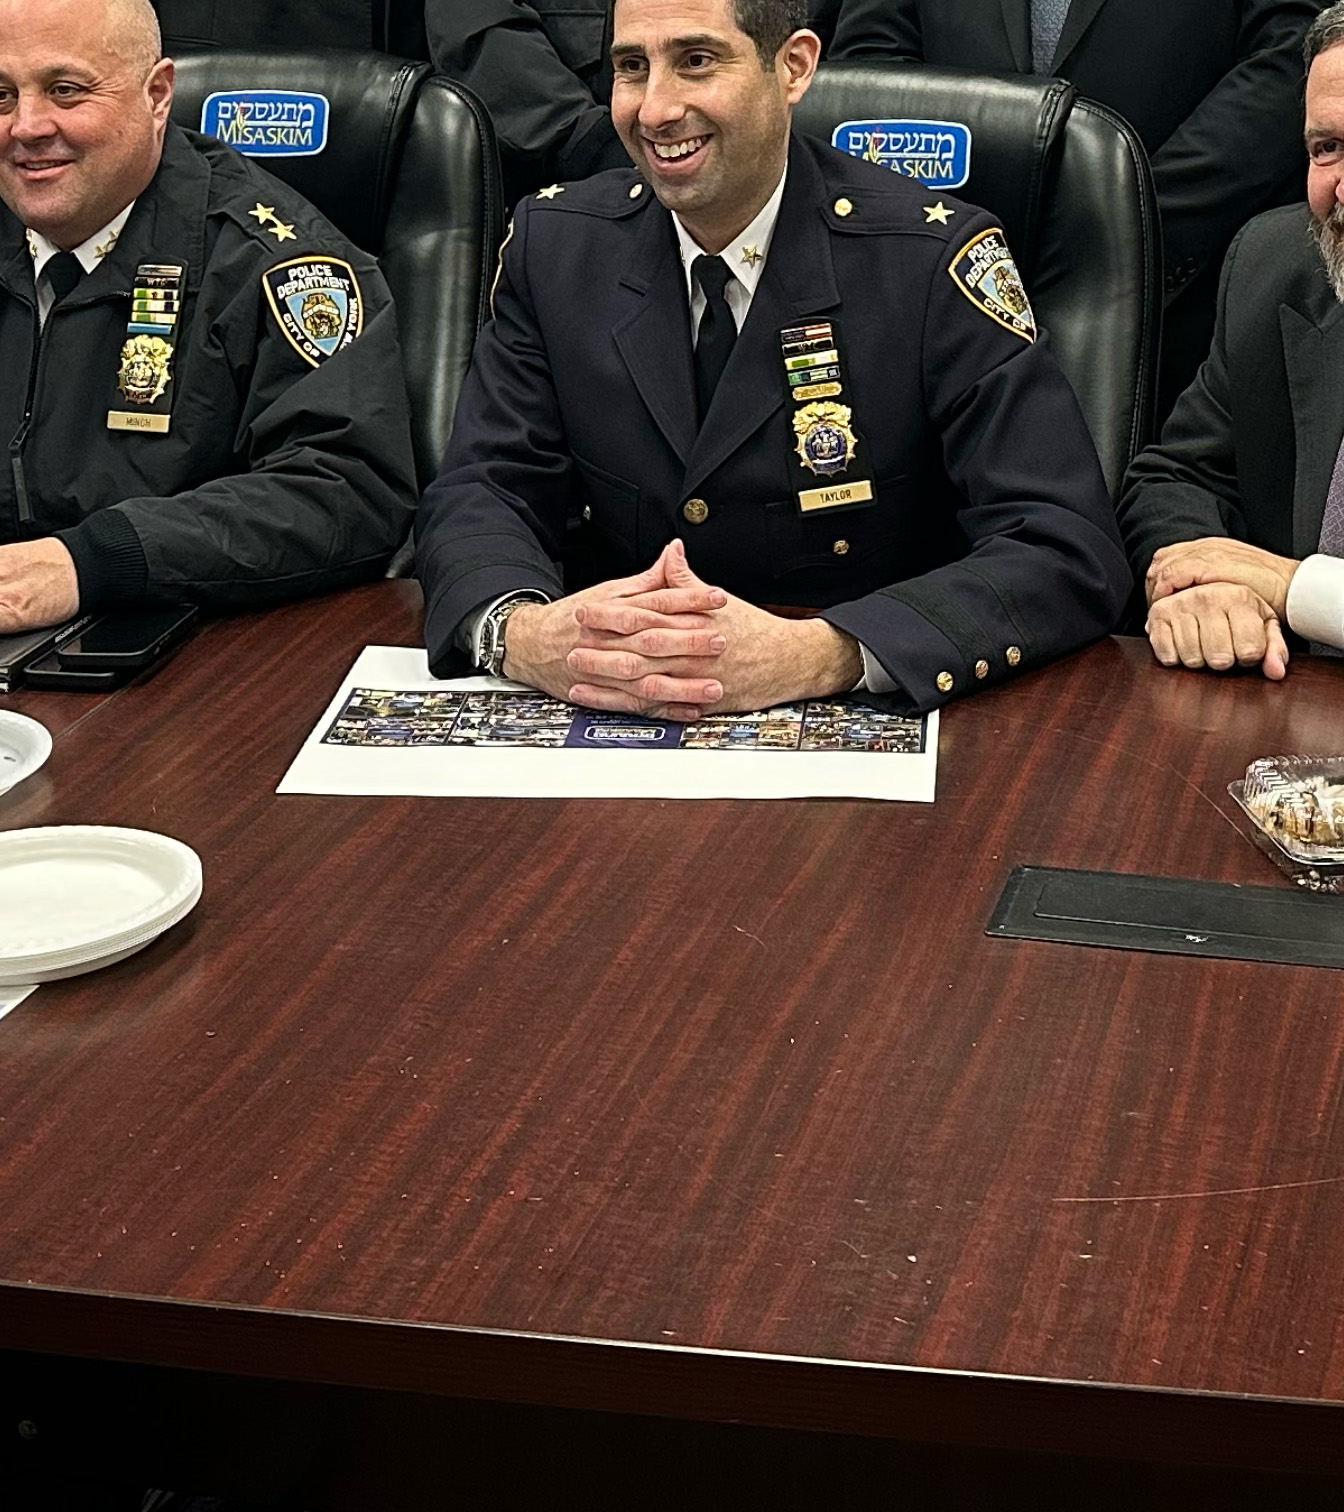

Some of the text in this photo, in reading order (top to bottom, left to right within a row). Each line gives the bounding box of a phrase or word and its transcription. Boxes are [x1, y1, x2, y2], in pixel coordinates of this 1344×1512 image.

[967, 235, 999, 263] POLICE
[288, 265, 333, 281] POLICE
[276, 274, 351, 301] DEPARTMENT
[983, 297, 1011, 322] CITY
[282, 312, 306, 342] CITY
[819, 489, 853, 505] TAYLOR
